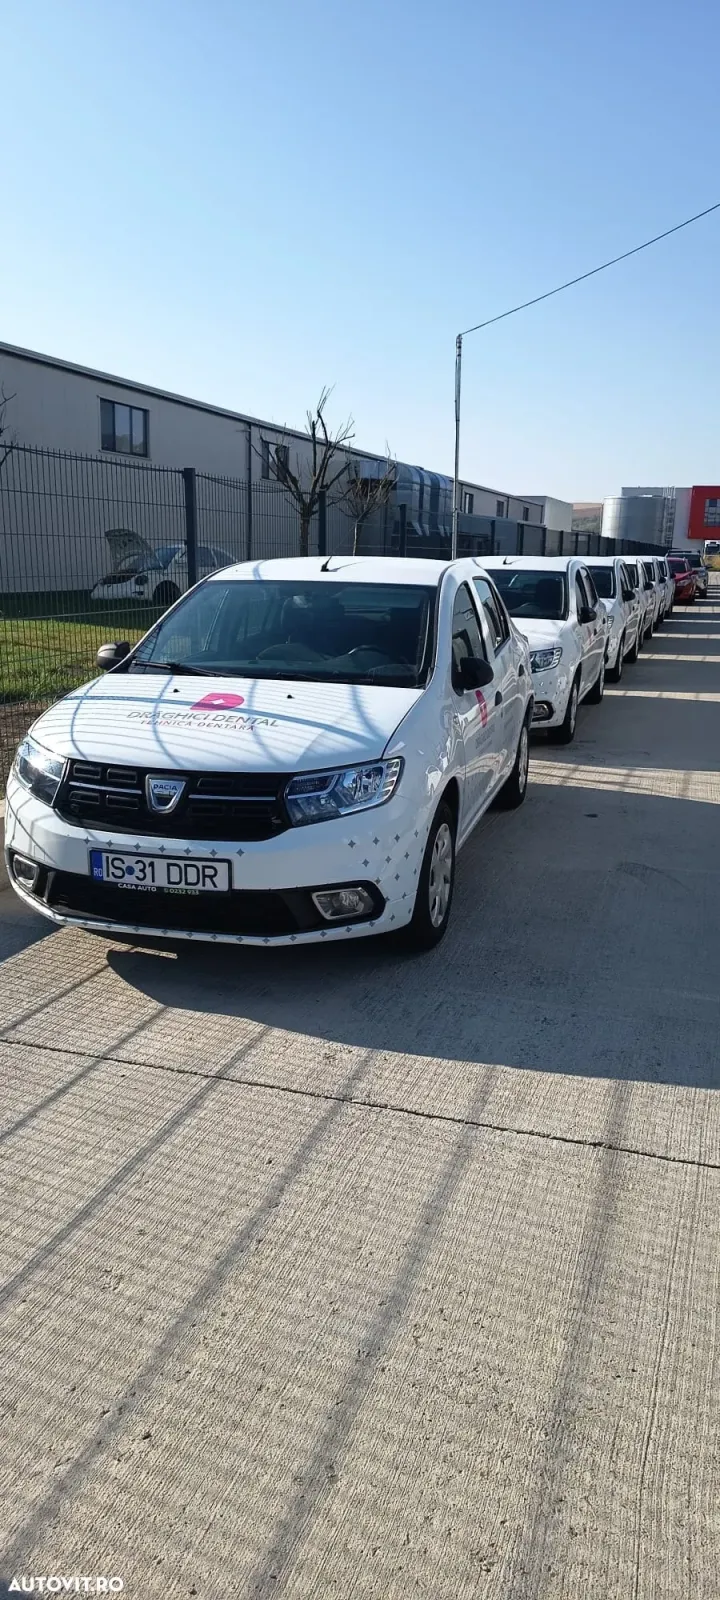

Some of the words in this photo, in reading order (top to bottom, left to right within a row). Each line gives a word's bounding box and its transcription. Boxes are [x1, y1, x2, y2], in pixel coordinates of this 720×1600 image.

[212, 714, 280, 728] DENTAL
[153, 783, 178, 791] DACIA
[93, 867, 103, 877] RO
[166, 862, 218, 889] DDR
[138, 884, 157, 892] AUTO
